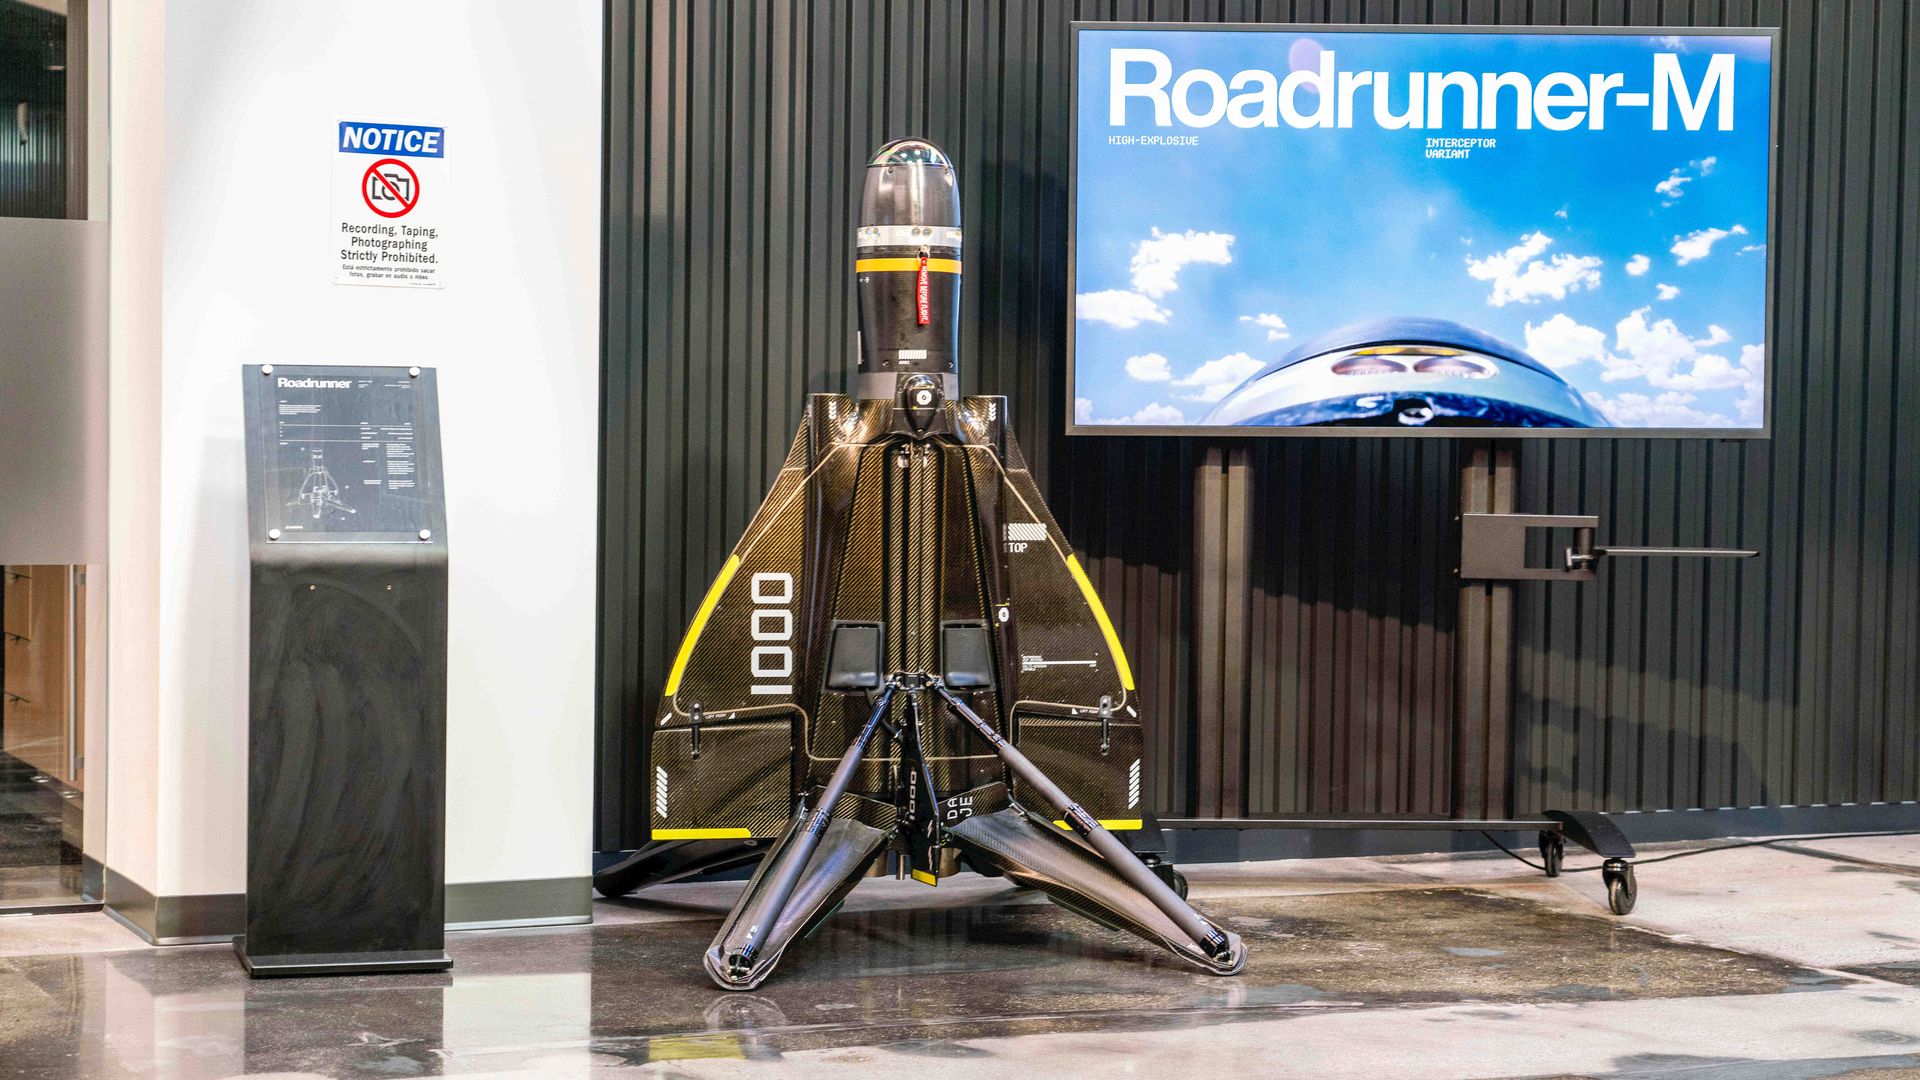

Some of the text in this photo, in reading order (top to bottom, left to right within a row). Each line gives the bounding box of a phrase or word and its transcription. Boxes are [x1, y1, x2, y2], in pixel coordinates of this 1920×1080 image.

[1108, 48, 1735, 131] Roadrunner-M
[342, 126, 440, 153] NOTICE
[1108, 136, 1199, 146] HIGH-EXPLOSIVE
[1425, 138, 1497, 148] INTERCEPTOR
[1425, 149, 1471, 158] VARIANT
[341, 222, 438, 239] Recording, Taping,
[351, 236, 428, 252] Photographing
[340, 249, 438, 264] Strictly Prohibited.
[277, 377, 352, 389] Roadrunner
[1008, 542, 1028, 553] TOP
[750, 572, 793, 694] 1000
